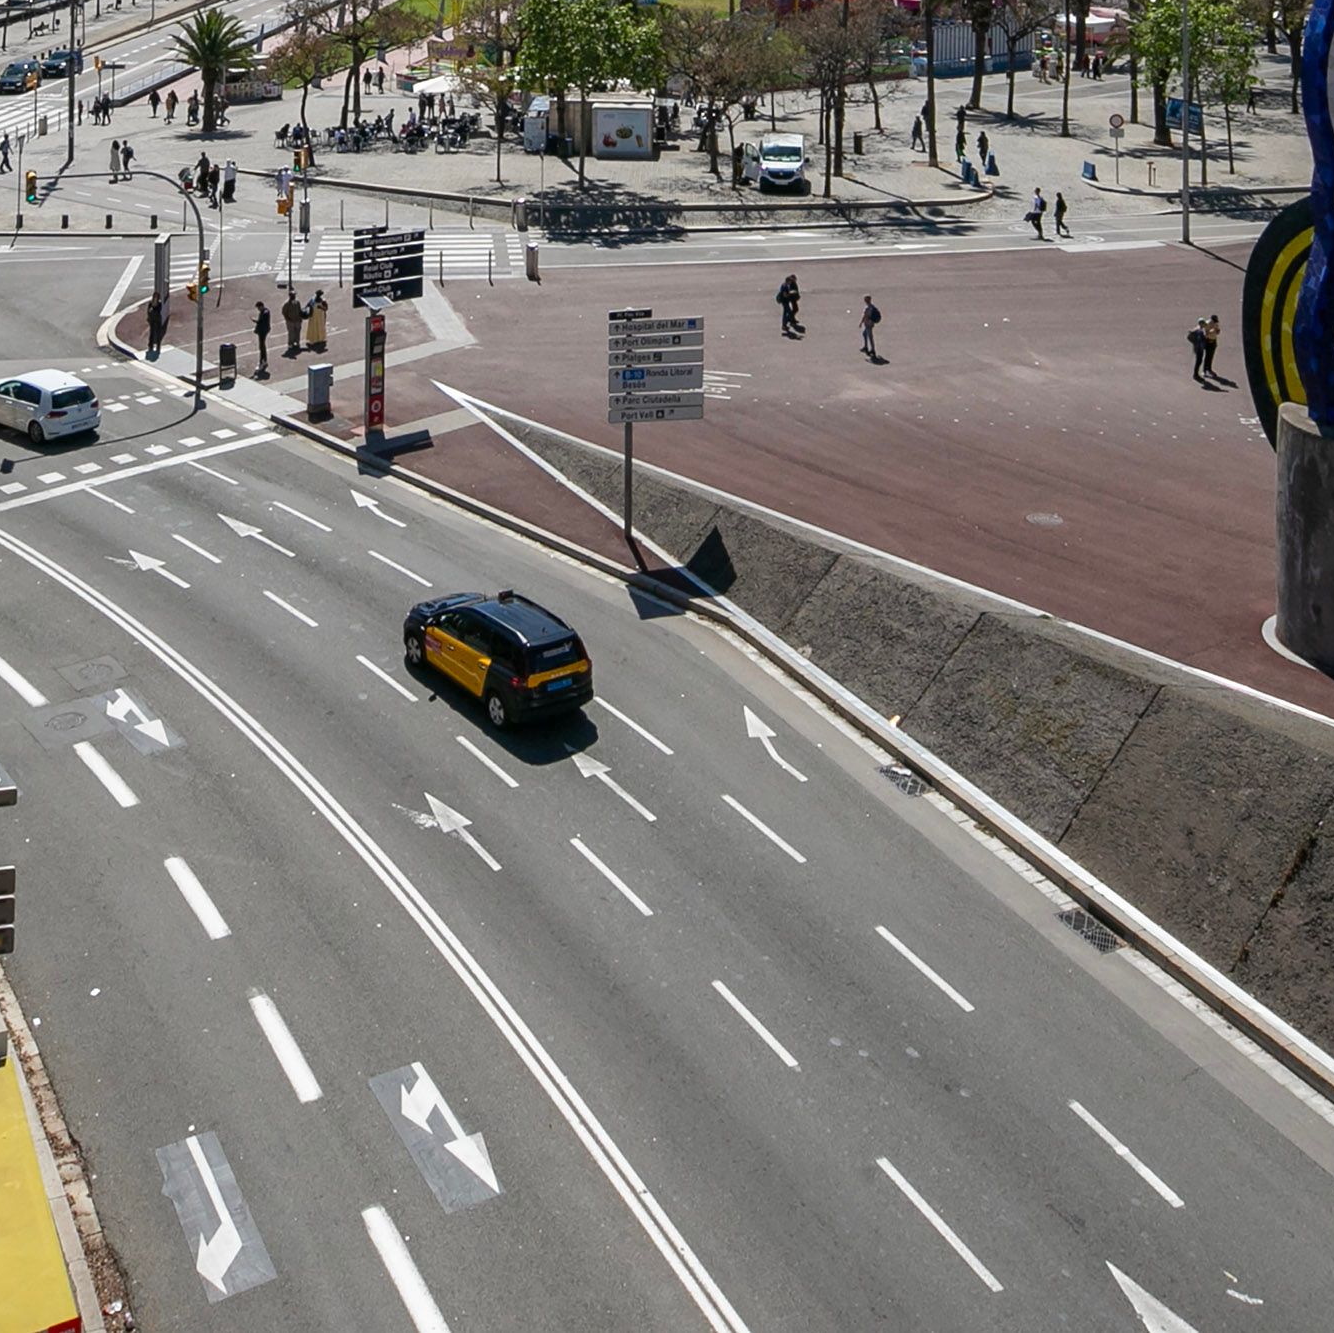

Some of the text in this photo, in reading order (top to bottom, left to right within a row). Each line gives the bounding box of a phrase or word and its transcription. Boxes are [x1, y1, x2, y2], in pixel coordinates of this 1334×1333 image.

[622, 319, 685, 332] Hospital del Mar
[622, 338, 639, 347] Port
[646, 368, 668, 377] Ronda
[670, 367, 693, 376] Litoral
[622, 394, 681, 405] Parc Ciutadella
[621, 409, 654, 420] Port Vell
